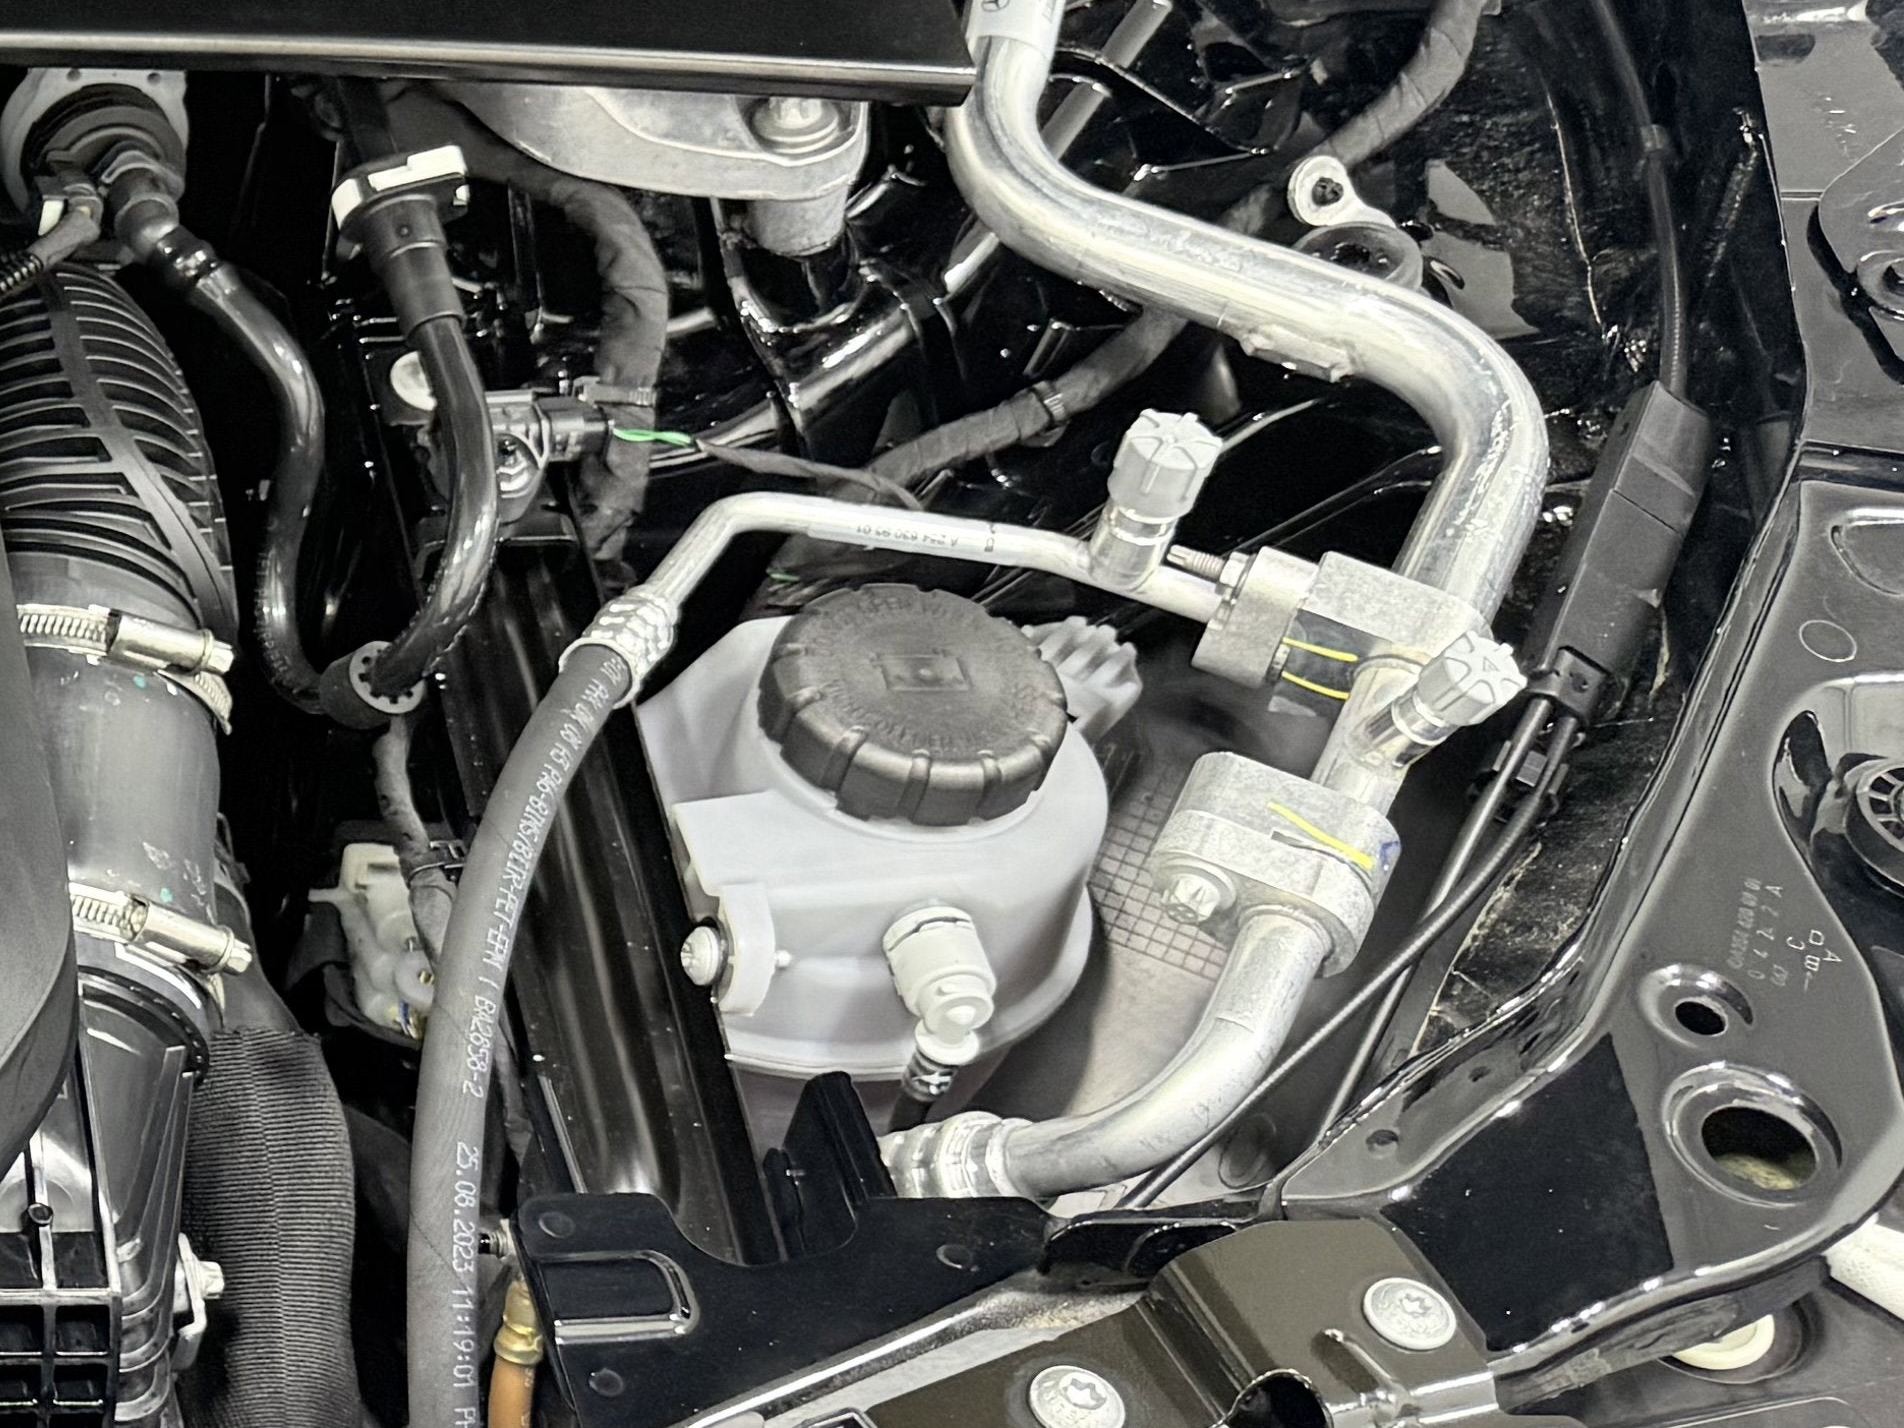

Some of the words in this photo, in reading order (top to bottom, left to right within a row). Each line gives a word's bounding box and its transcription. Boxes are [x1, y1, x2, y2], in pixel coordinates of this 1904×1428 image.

[1822, 948, 1843, 963] A
[452, 1141, 479, 1273] 25.08.2023
[451, 1288, 476, 1388] 11:19:01
